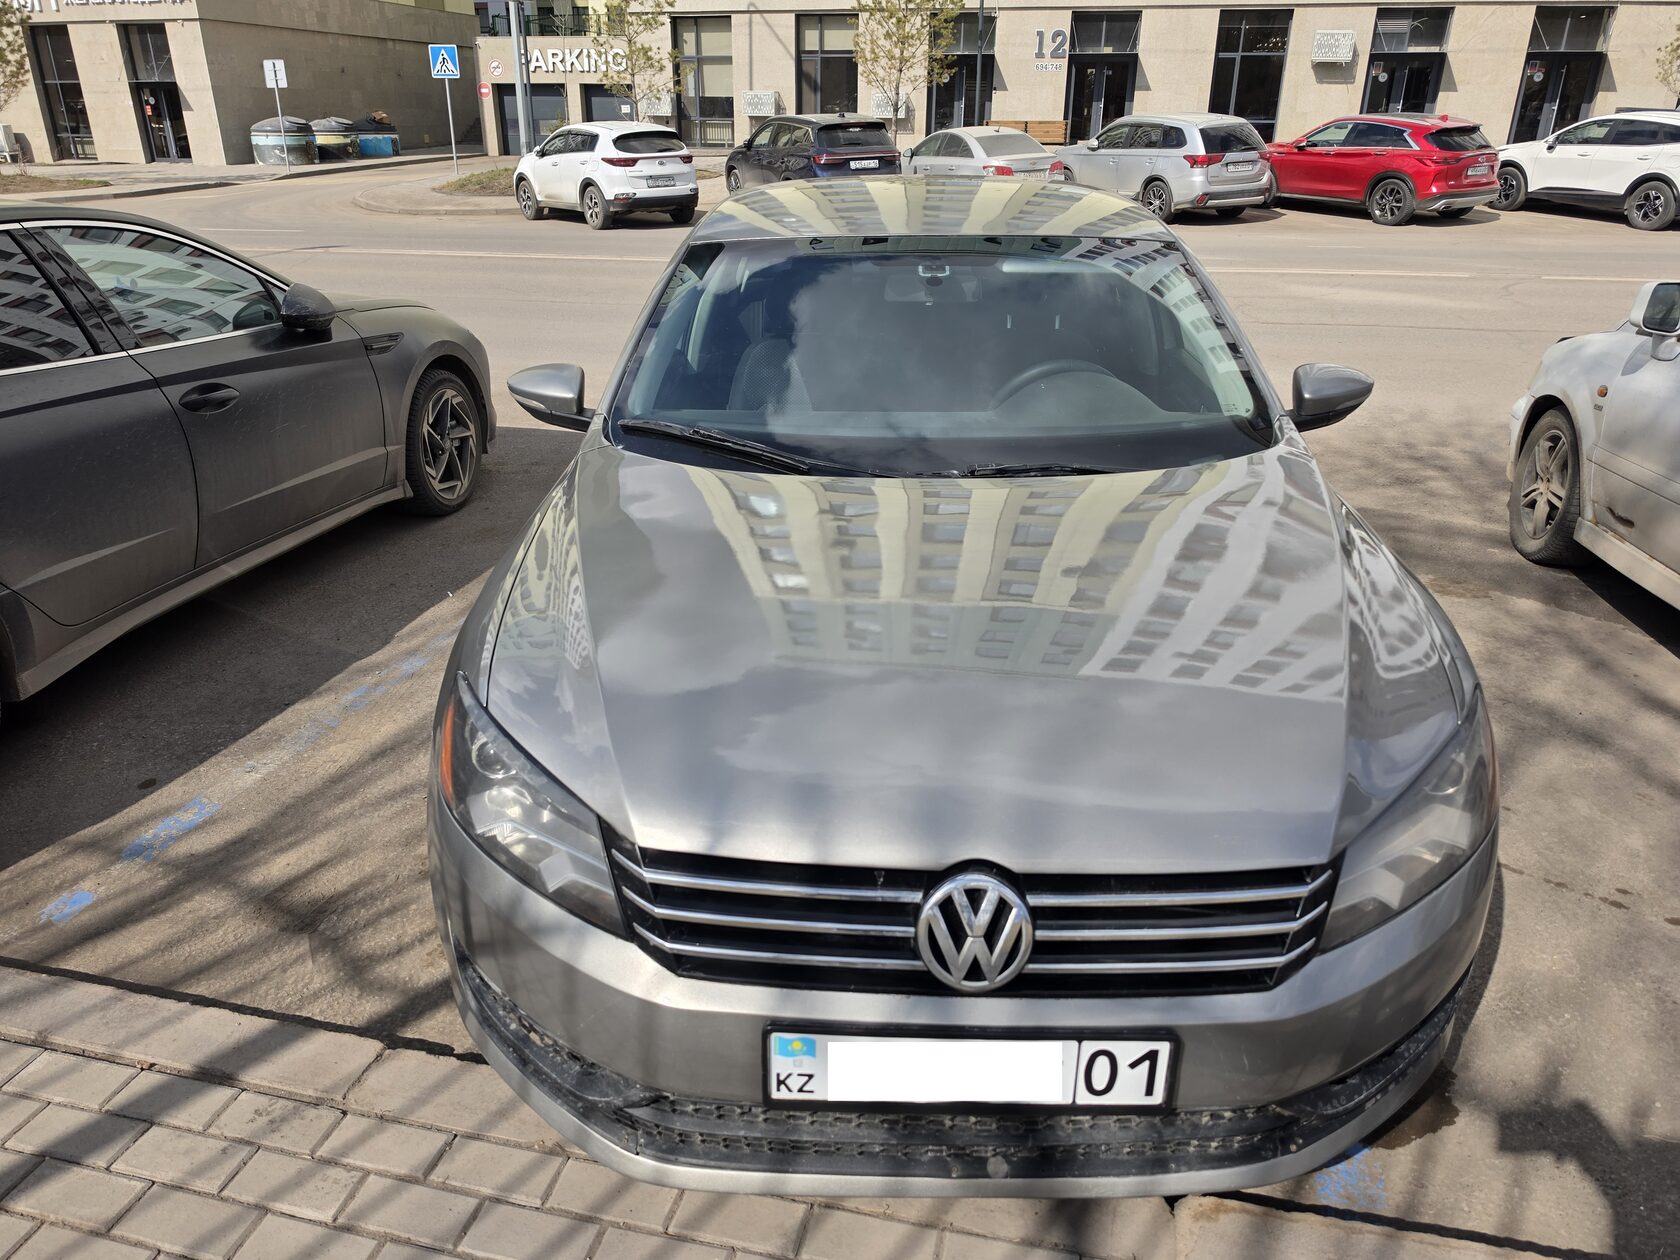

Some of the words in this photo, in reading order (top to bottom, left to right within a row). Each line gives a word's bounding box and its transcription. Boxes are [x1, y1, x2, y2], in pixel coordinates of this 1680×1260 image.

[1034, 29, 1068, 58] 12
[1035, 63, 1064, 71] 694-748
[776, 1072, 815, 1094] KZ
[1084, 1049, 1159, 1097] 01
